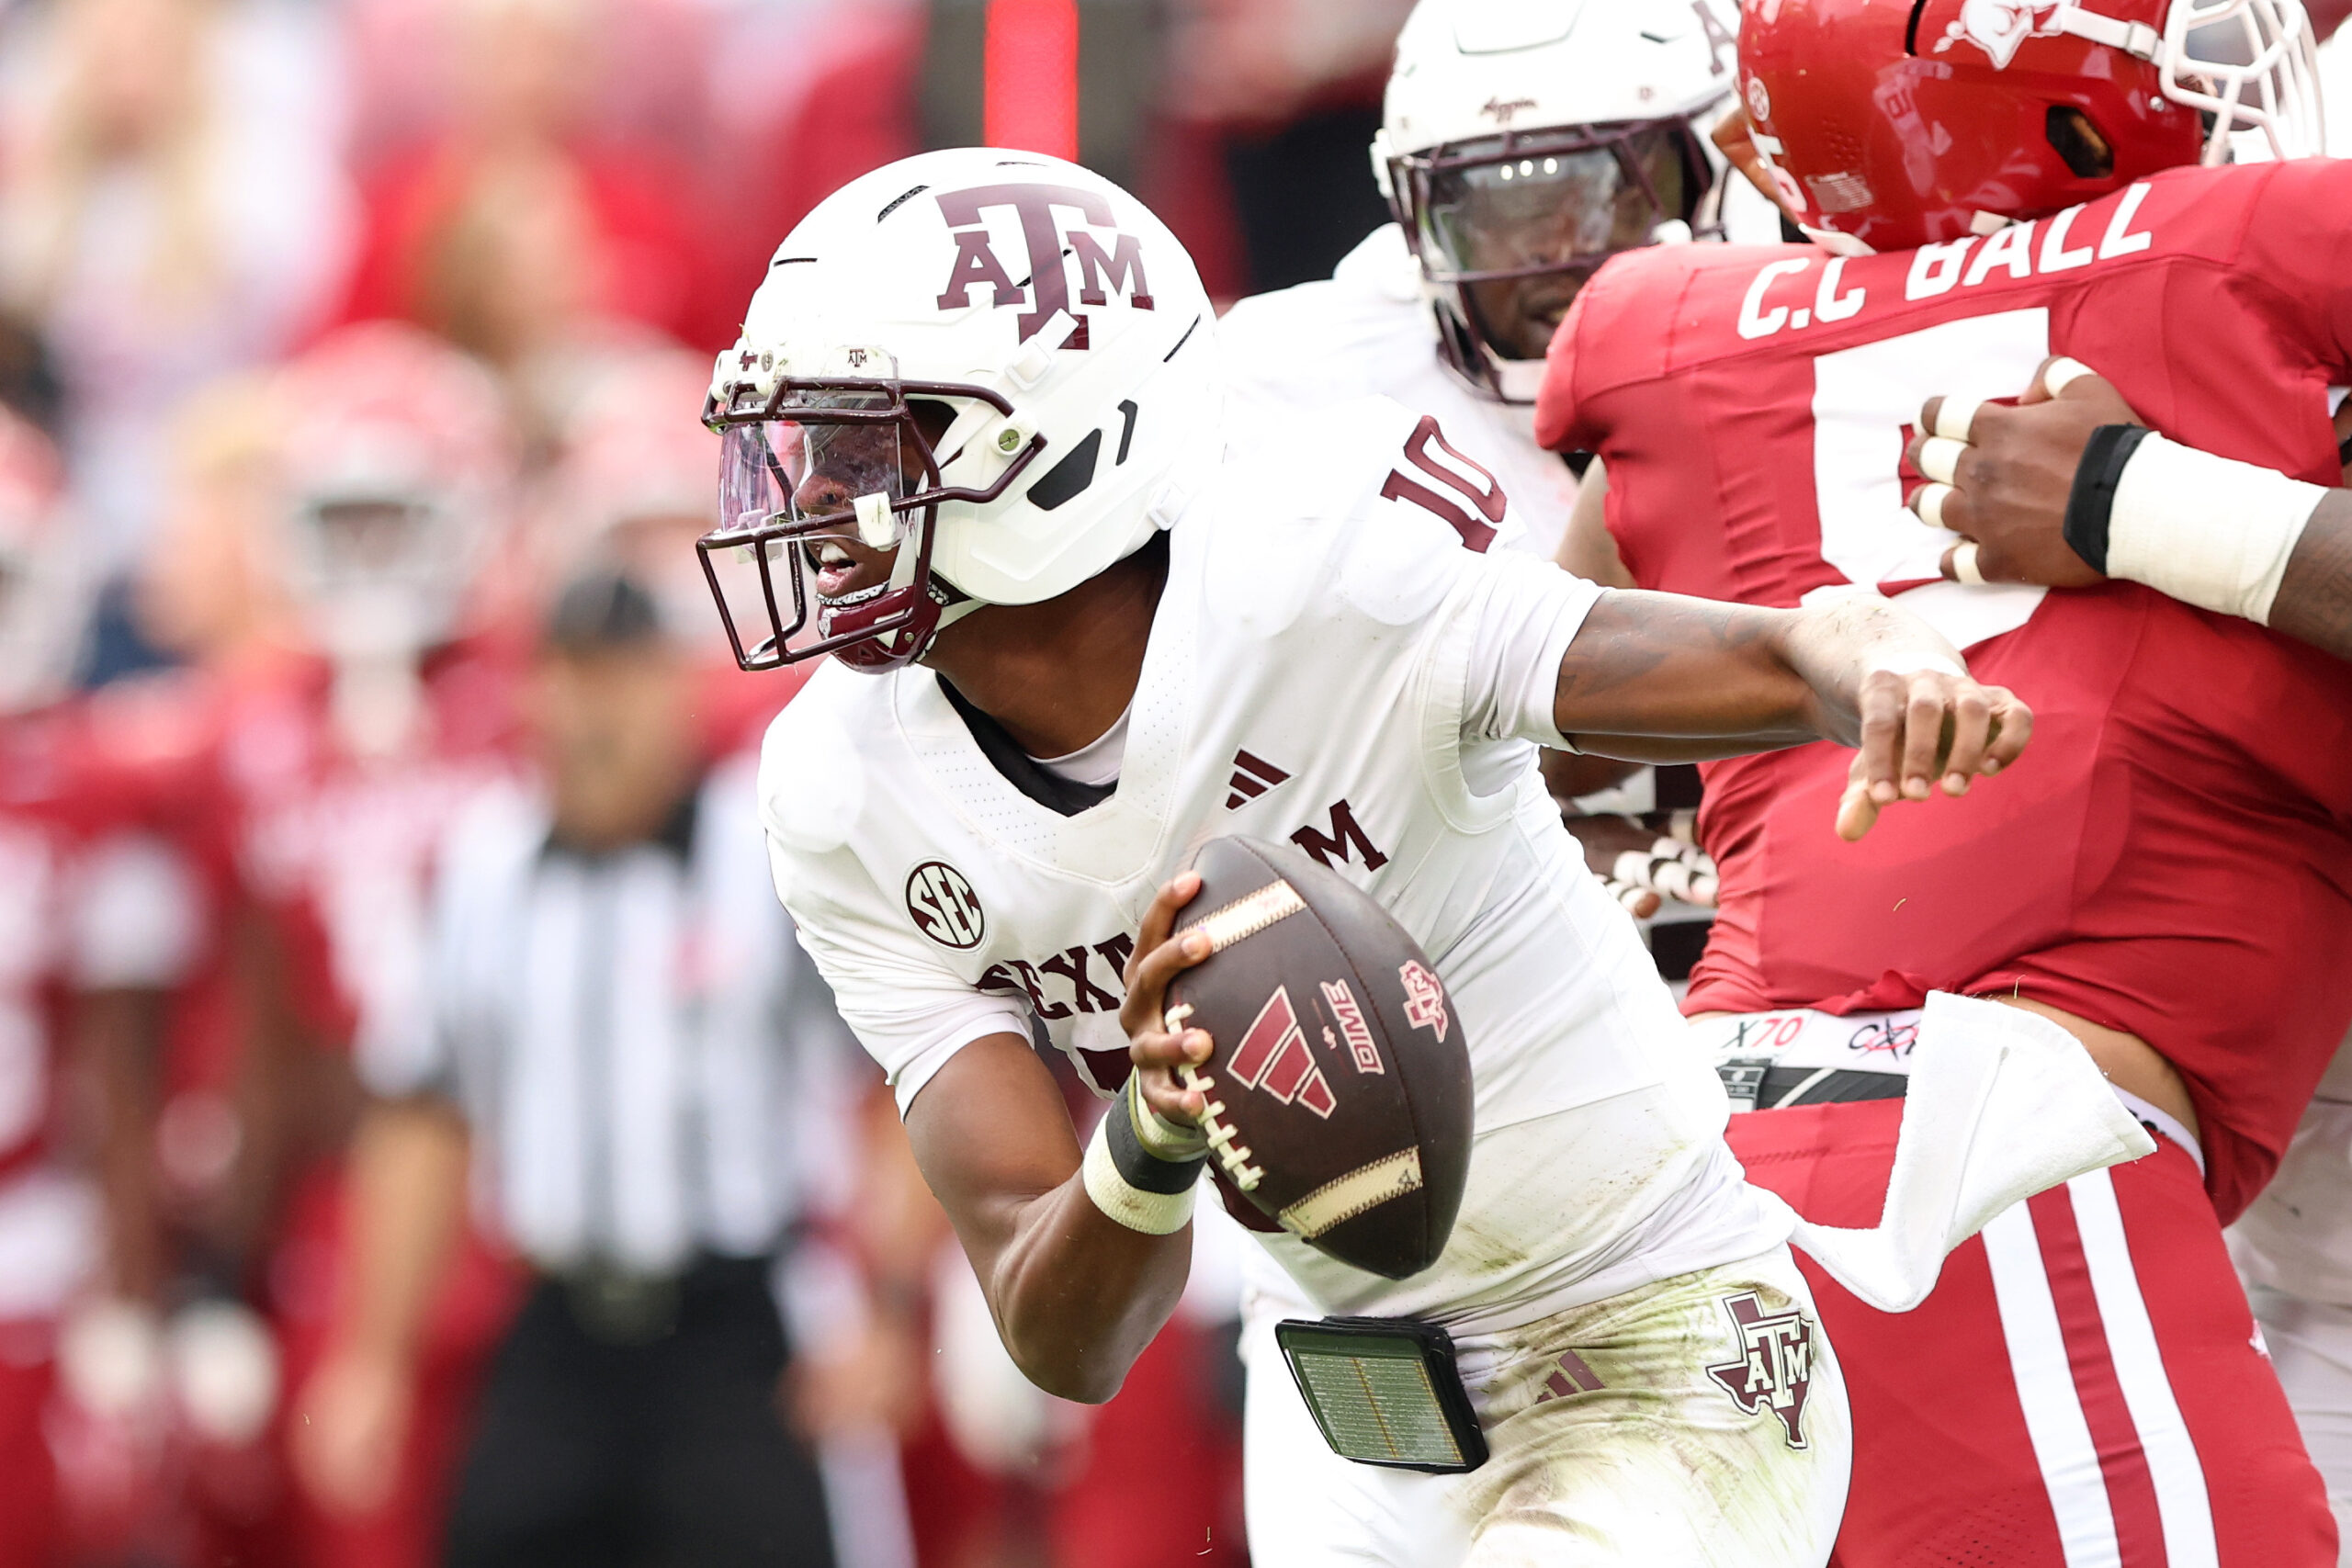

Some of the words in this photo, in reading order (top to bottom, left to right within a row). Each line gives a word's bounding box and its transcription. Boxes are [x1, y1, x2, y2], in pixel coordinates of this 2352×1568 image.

[1905, 182, 2152, 301] BALL
[1380, 415, 1507, 554] 10
[906, 862, 984, 949] SEC
[1319, 978, 1385, 1075] DIME
